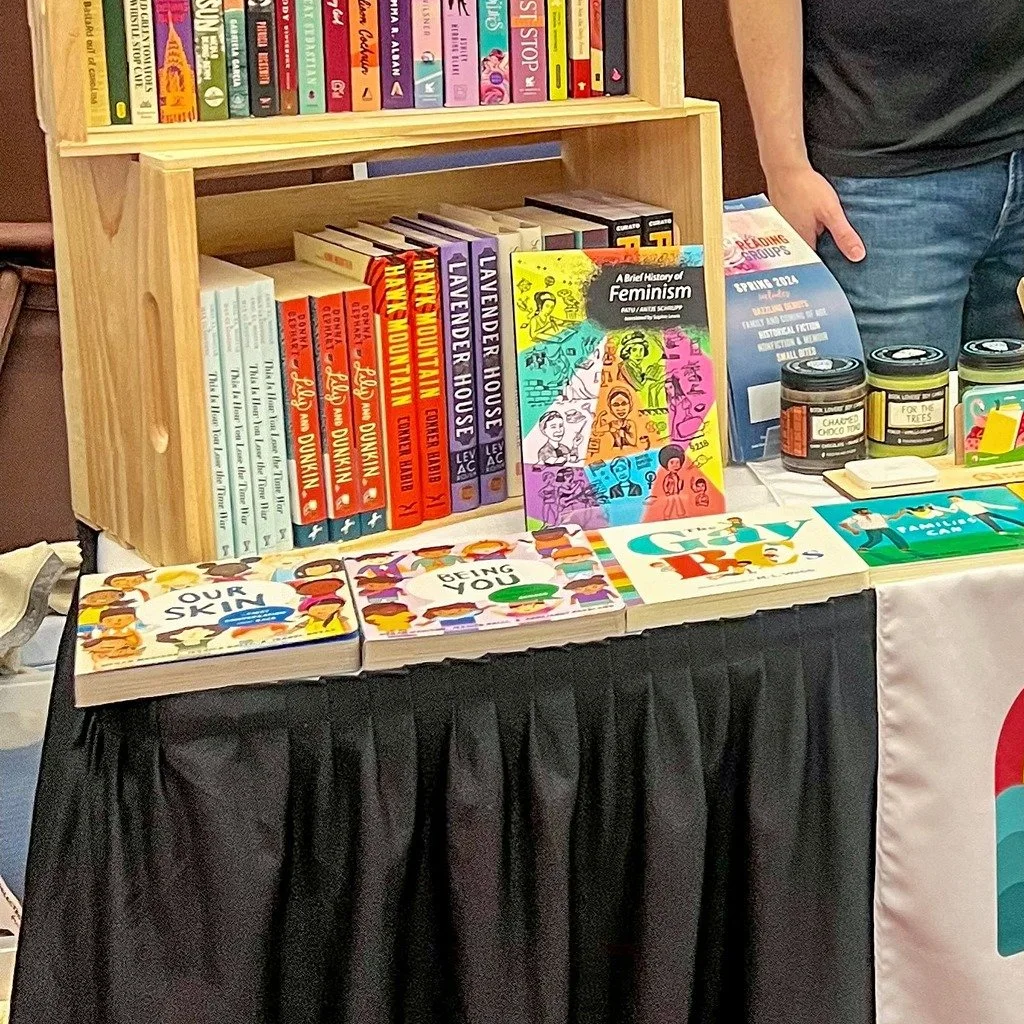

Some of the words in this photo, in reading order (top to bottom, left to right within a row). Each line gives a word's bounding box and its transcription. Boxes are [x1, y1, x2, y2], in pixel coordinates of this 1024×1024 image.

[390, 27, 400, 38] R.
[391, 41, 401, 76] ALBAN
[520, 28, 539, 72] STOP
[735, 234, 790, 251] READING
[742, 246, 792, 261] GROUPS
[616, 273, 624, 282] A
[626, 272, 644, 282] Brief
[644, 271, 674, 285] History
[675, 271, 684, 281] of
[733, 277, 773, 294] SPRING
[775, 275, 799, 288] 2024
[385, 264, 409, 314] HAWK
[609, 283, 693, 304] Feminism
[448, 261, 471, 365] LAVENDER
[388, 319, 412, 408] MOUNTAIN
[207, 371, 220, 393] This
[290, 372, 315, 411] Lily
[209, 395, 221, 404] Is
[454, 374, 474, 439] HOUSE
[210, 406, 222, 426] How
[300, 413, 308, 432] AND
[906, 412, 932, 423] TREES
[212, 430, 224, 445] You
[213, 447, 225, 469] Lose
[298, 433, 320, 490] DUNKIN
[215, 471, 227, 484] the
[216, 486, 228, 509] Time
[218, 512, 229, 531] War
[897, 518, 977, 533] FAMILIES
[925, 526, 964, 538] CAN
[436, 563, 515, 585] BEING
[178, 584, 247, 604] OUR
[442, 573, 522, 596] YOU
[164, 593, 266, 621] SKIN
